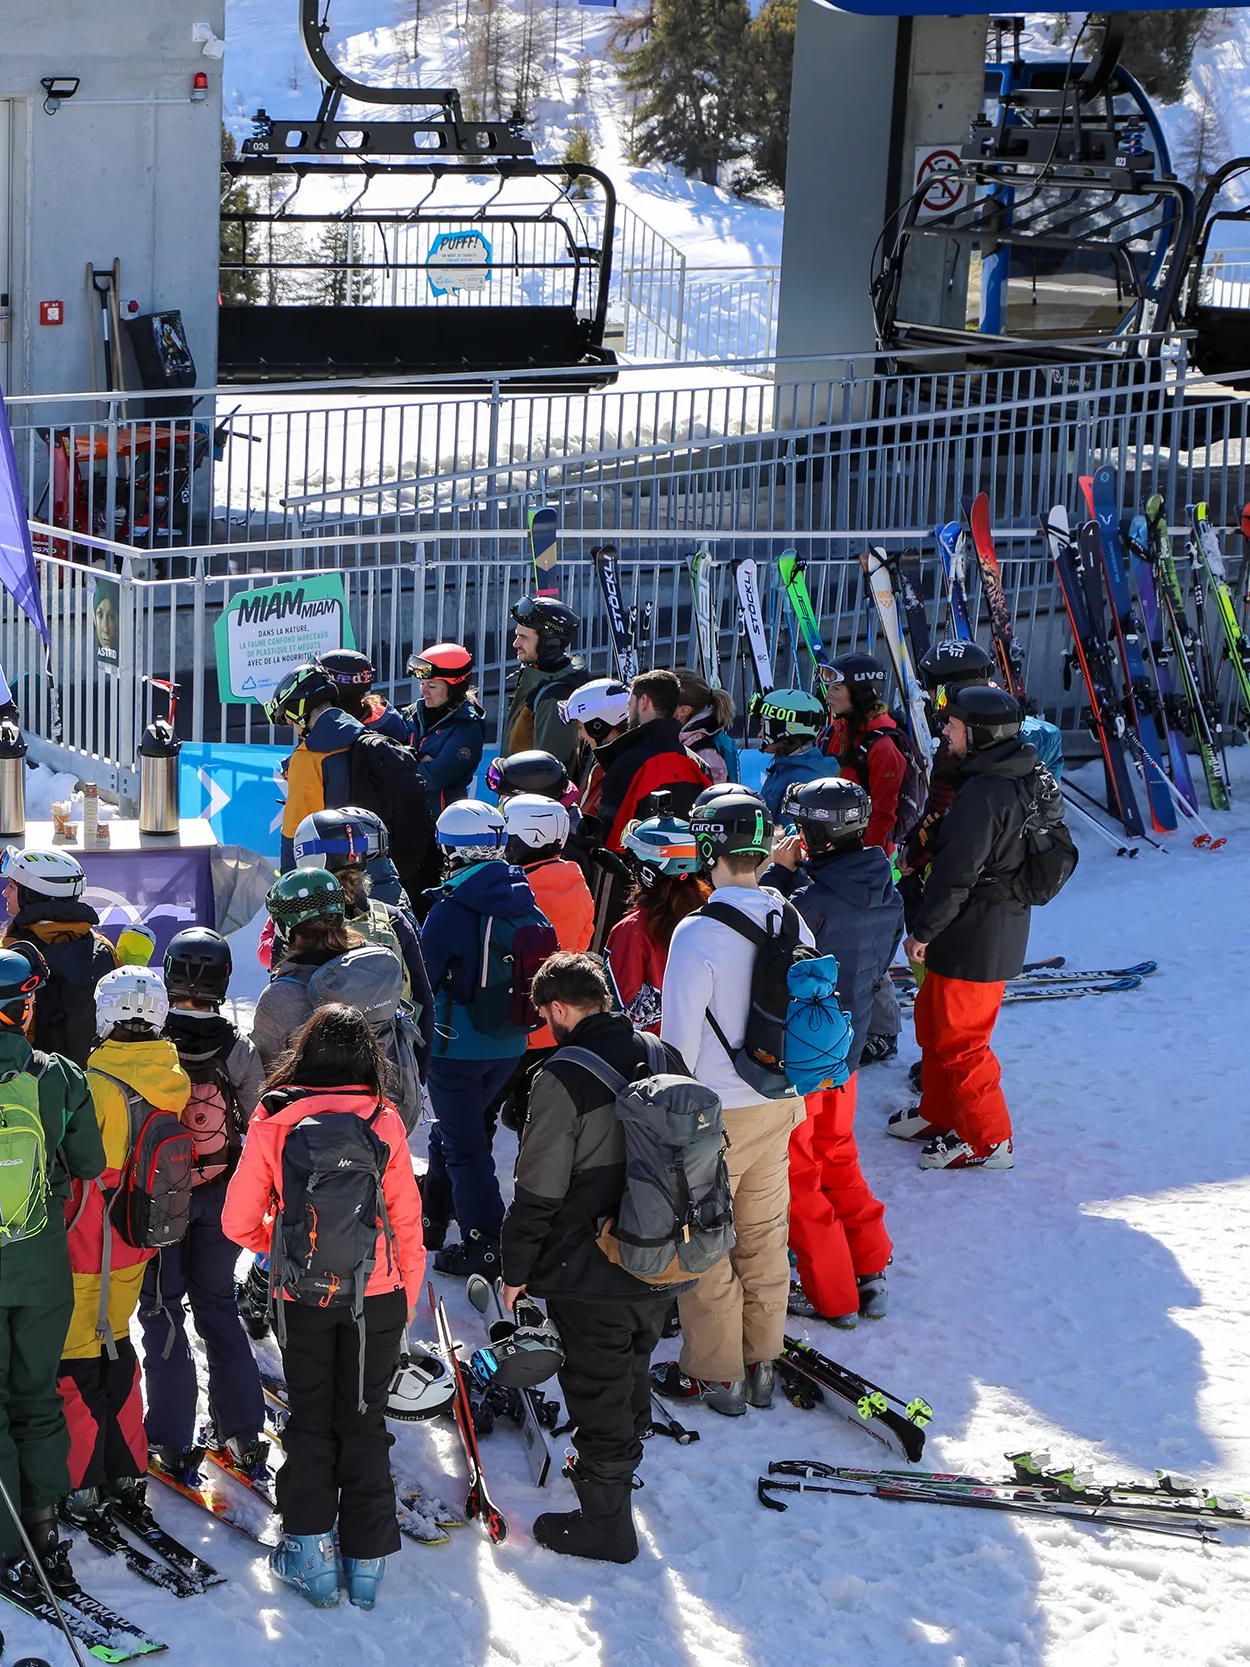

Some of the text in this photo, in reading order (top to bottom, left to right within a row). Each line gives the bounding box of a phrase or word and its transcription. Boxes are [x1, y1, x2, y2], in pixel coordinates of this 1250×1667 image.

[253, 142, 269, 150] 024
[440, 234, 479, 251] PUFFF!
[237, 588, 337, 627] MIAM MIAM
[258, 625, 310, 637] DANS LA NATURE,
[545, 621, 564, 633] anon
[248, 639, 266, 648] FAUNE
[268, 636, 295, 645] CONFOND
[297, 632, 328, 642] MORCEAUX
[247, 650, 255, 658] DE
[256, 647, 288, 656] PLASTIQUE
[247, 659, 262, 667] AVEC
[691, 823, 724, 833] GIRO
[372, 1000, 393, 1011] VAUDE
[965, 1154, 1000, 1165] HEAD
[787, 1301, 815, 1310] HEA
